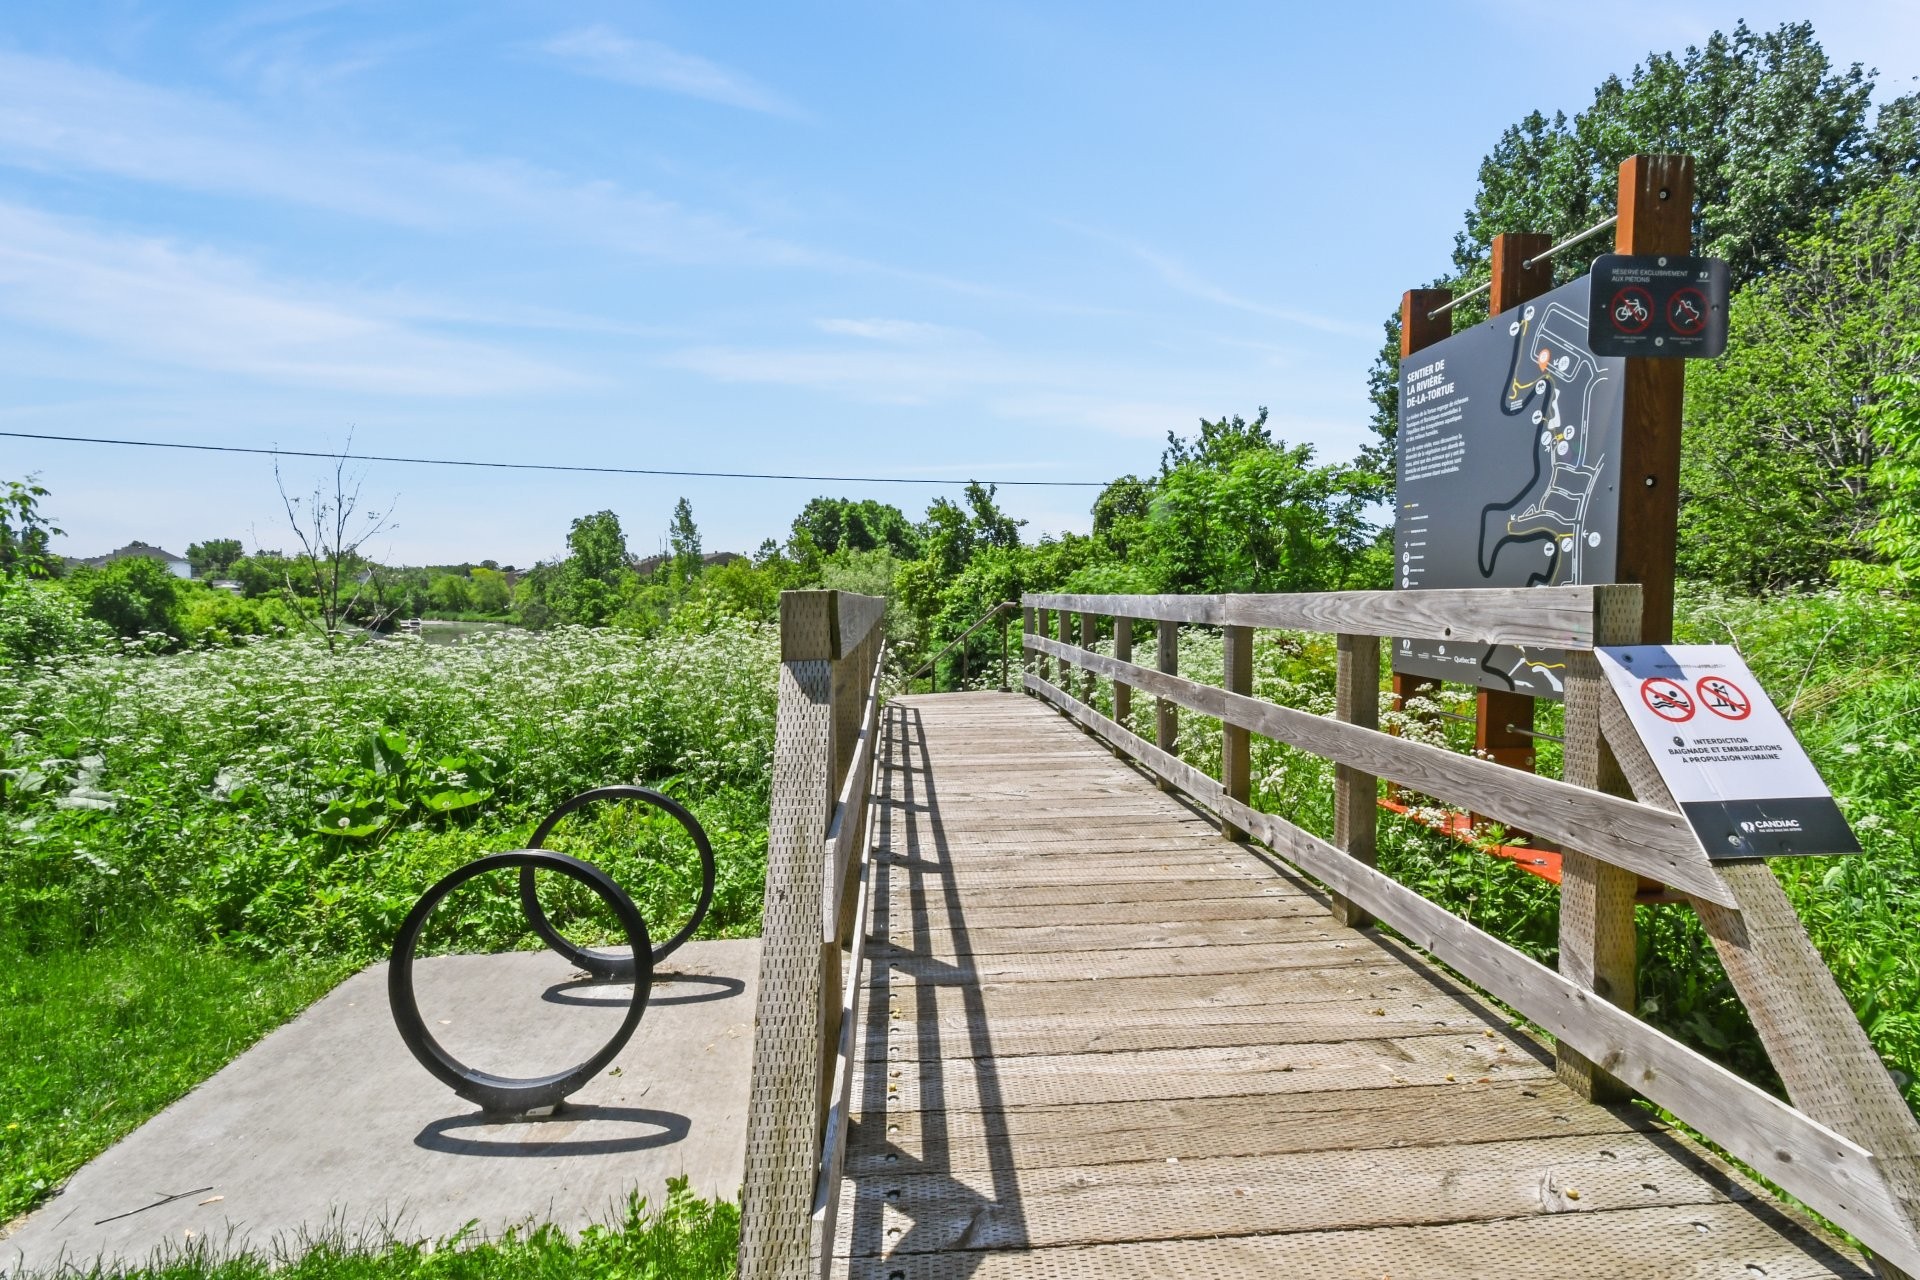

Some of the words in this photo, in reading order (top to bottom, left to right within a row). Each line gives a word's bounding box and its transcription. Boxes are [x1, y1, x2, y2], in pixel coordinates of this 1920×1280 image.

[1407, 364, 1434, 383] SENTIER
[1435, 359, 1445, 371] DE
[1407, 385, 1416, 396] LA
[1416, 374, 1445, 393] RIVIÈRE-
[1406, 382, 1455, 409] DE-LA-TORTUE
[1693, 737, 1749, 745] INTERDICTION
[1668, 747, 1710, 755] BAIGNADE
[1721, 744, 1783, 753] EMBARCATIONS
[1689, 755, 1741, 763] PROPULSION
[1741, 753, 1780, 761] HUMAINE
[1754, 819, 1799, 828] CANDIAC
